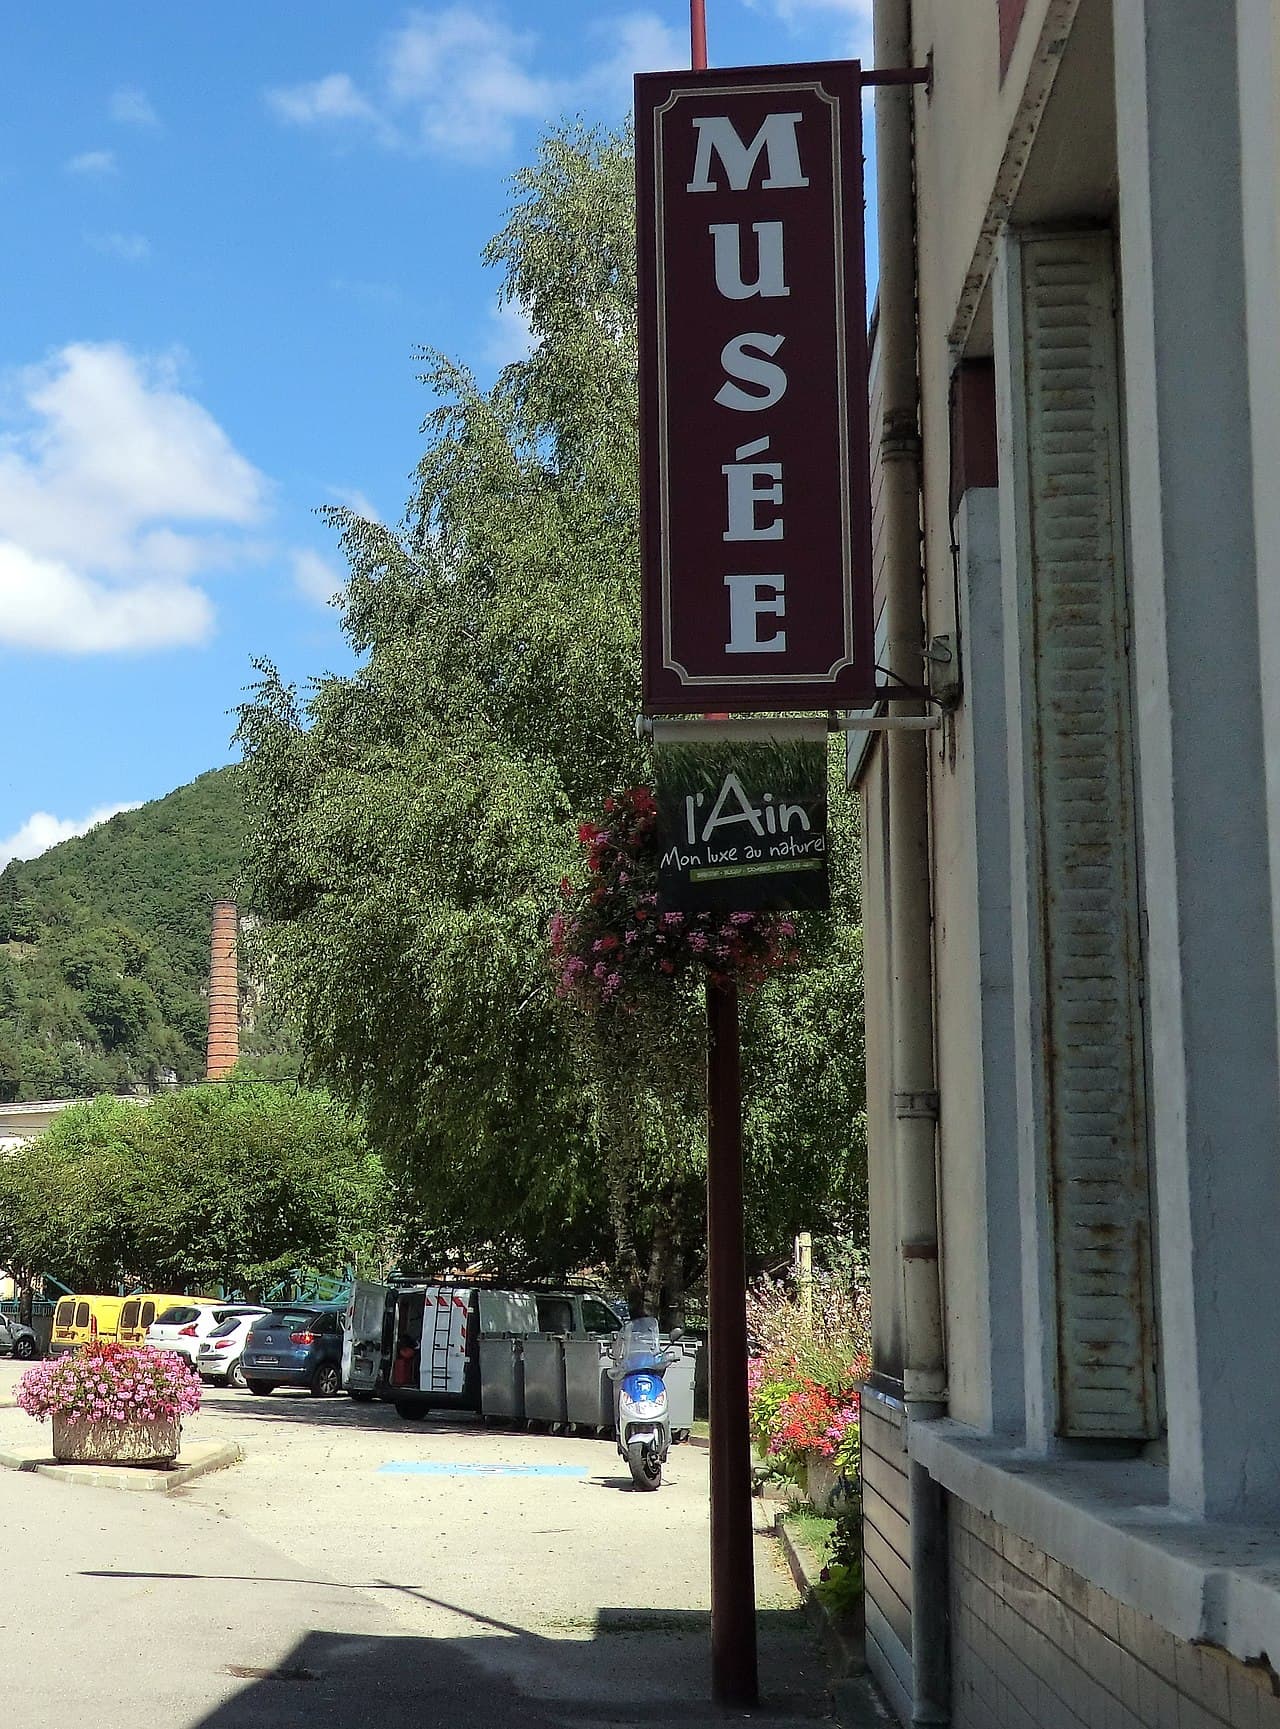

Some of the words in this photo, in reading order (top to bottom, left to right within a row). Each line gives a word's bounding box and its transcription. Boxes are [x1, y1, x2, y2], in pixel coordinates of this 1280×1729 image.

[686, 111, 810, 656] MUSÉE
[685, 772, 811, 845] l'Ain
[660, 846, 701, 872] Mon
[707, 845, 738, 864] luxe
[745, 844, 762, 859] au
[769, 834, 826, 858] naturel
